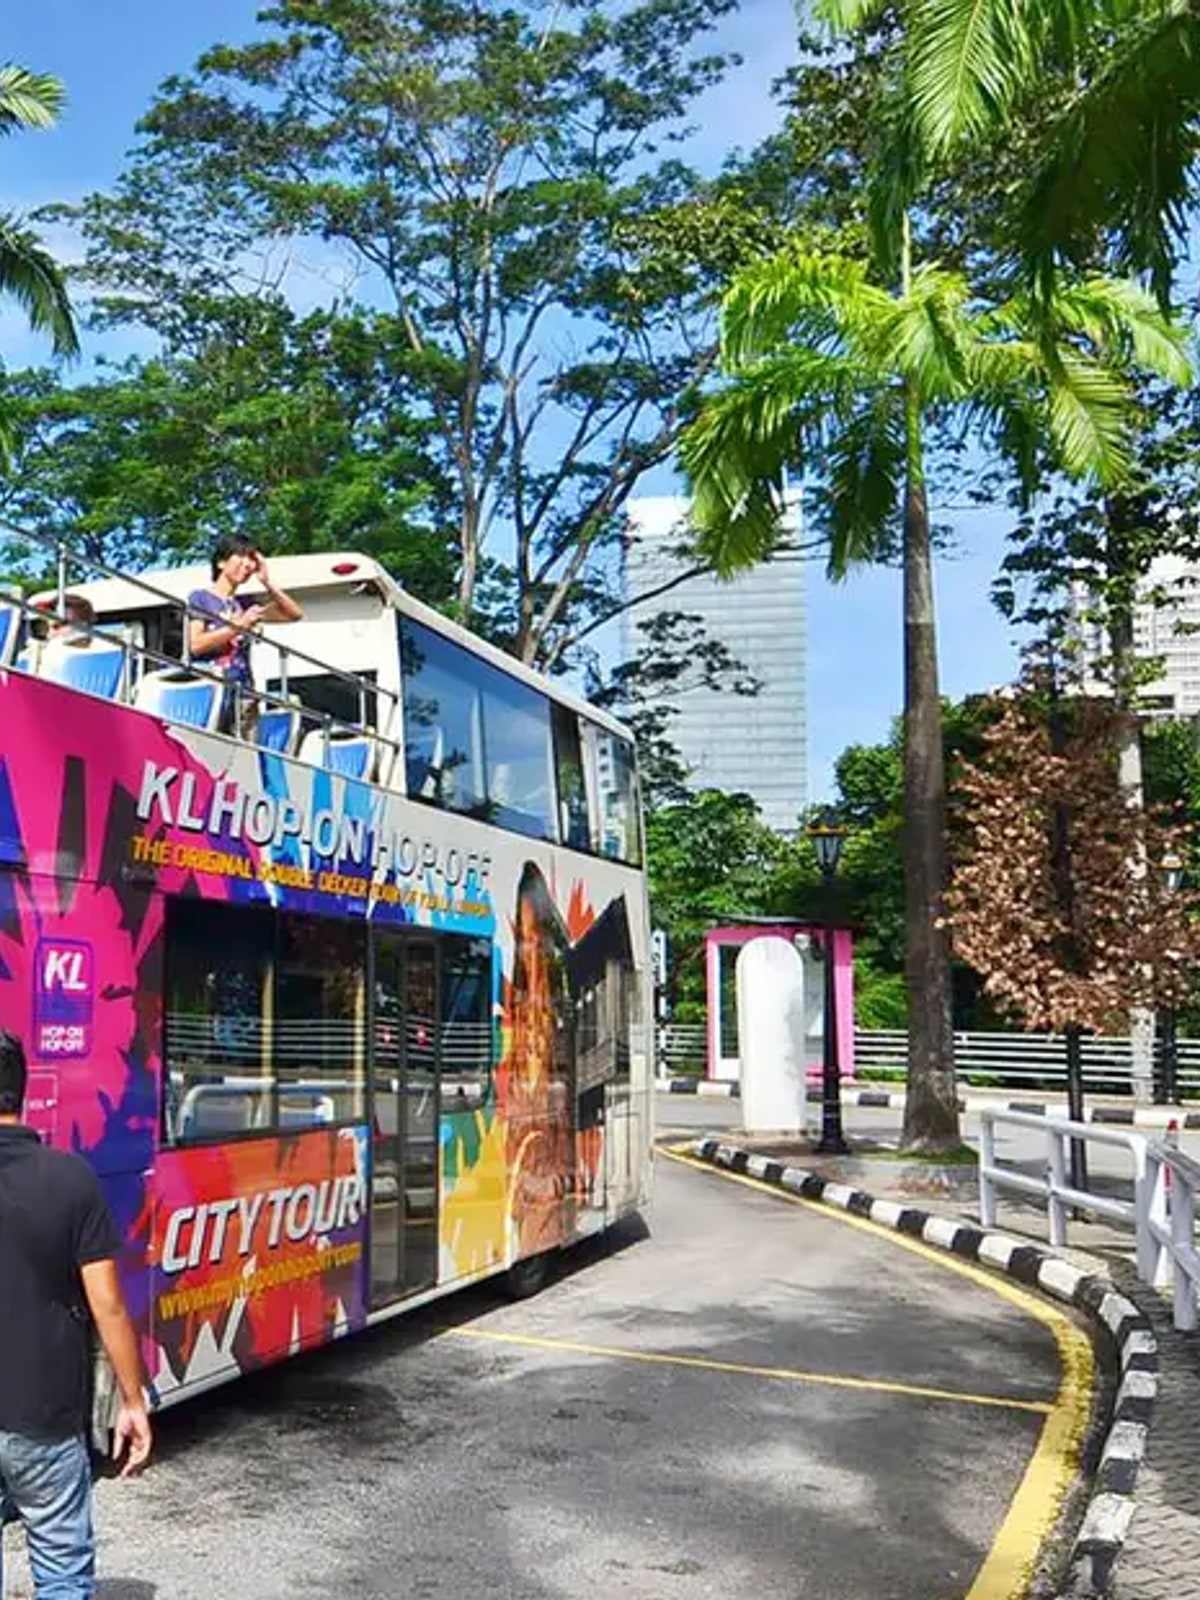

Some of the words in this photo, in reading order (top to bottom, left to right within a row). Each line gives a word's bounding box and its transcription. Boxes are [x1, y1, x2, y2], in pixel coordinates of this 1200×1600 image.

[136, 759, 205, 833] KL
[132, 836, 170, 867] THE
[173, 845, 253, 880] ORIGINAL
[320, 872, 367, 897] DECKER
[44, 951, 87, 991] KL
[161, 1194, 265, 1273] CITY
[266, 1174, 362, 1249] TOUR
